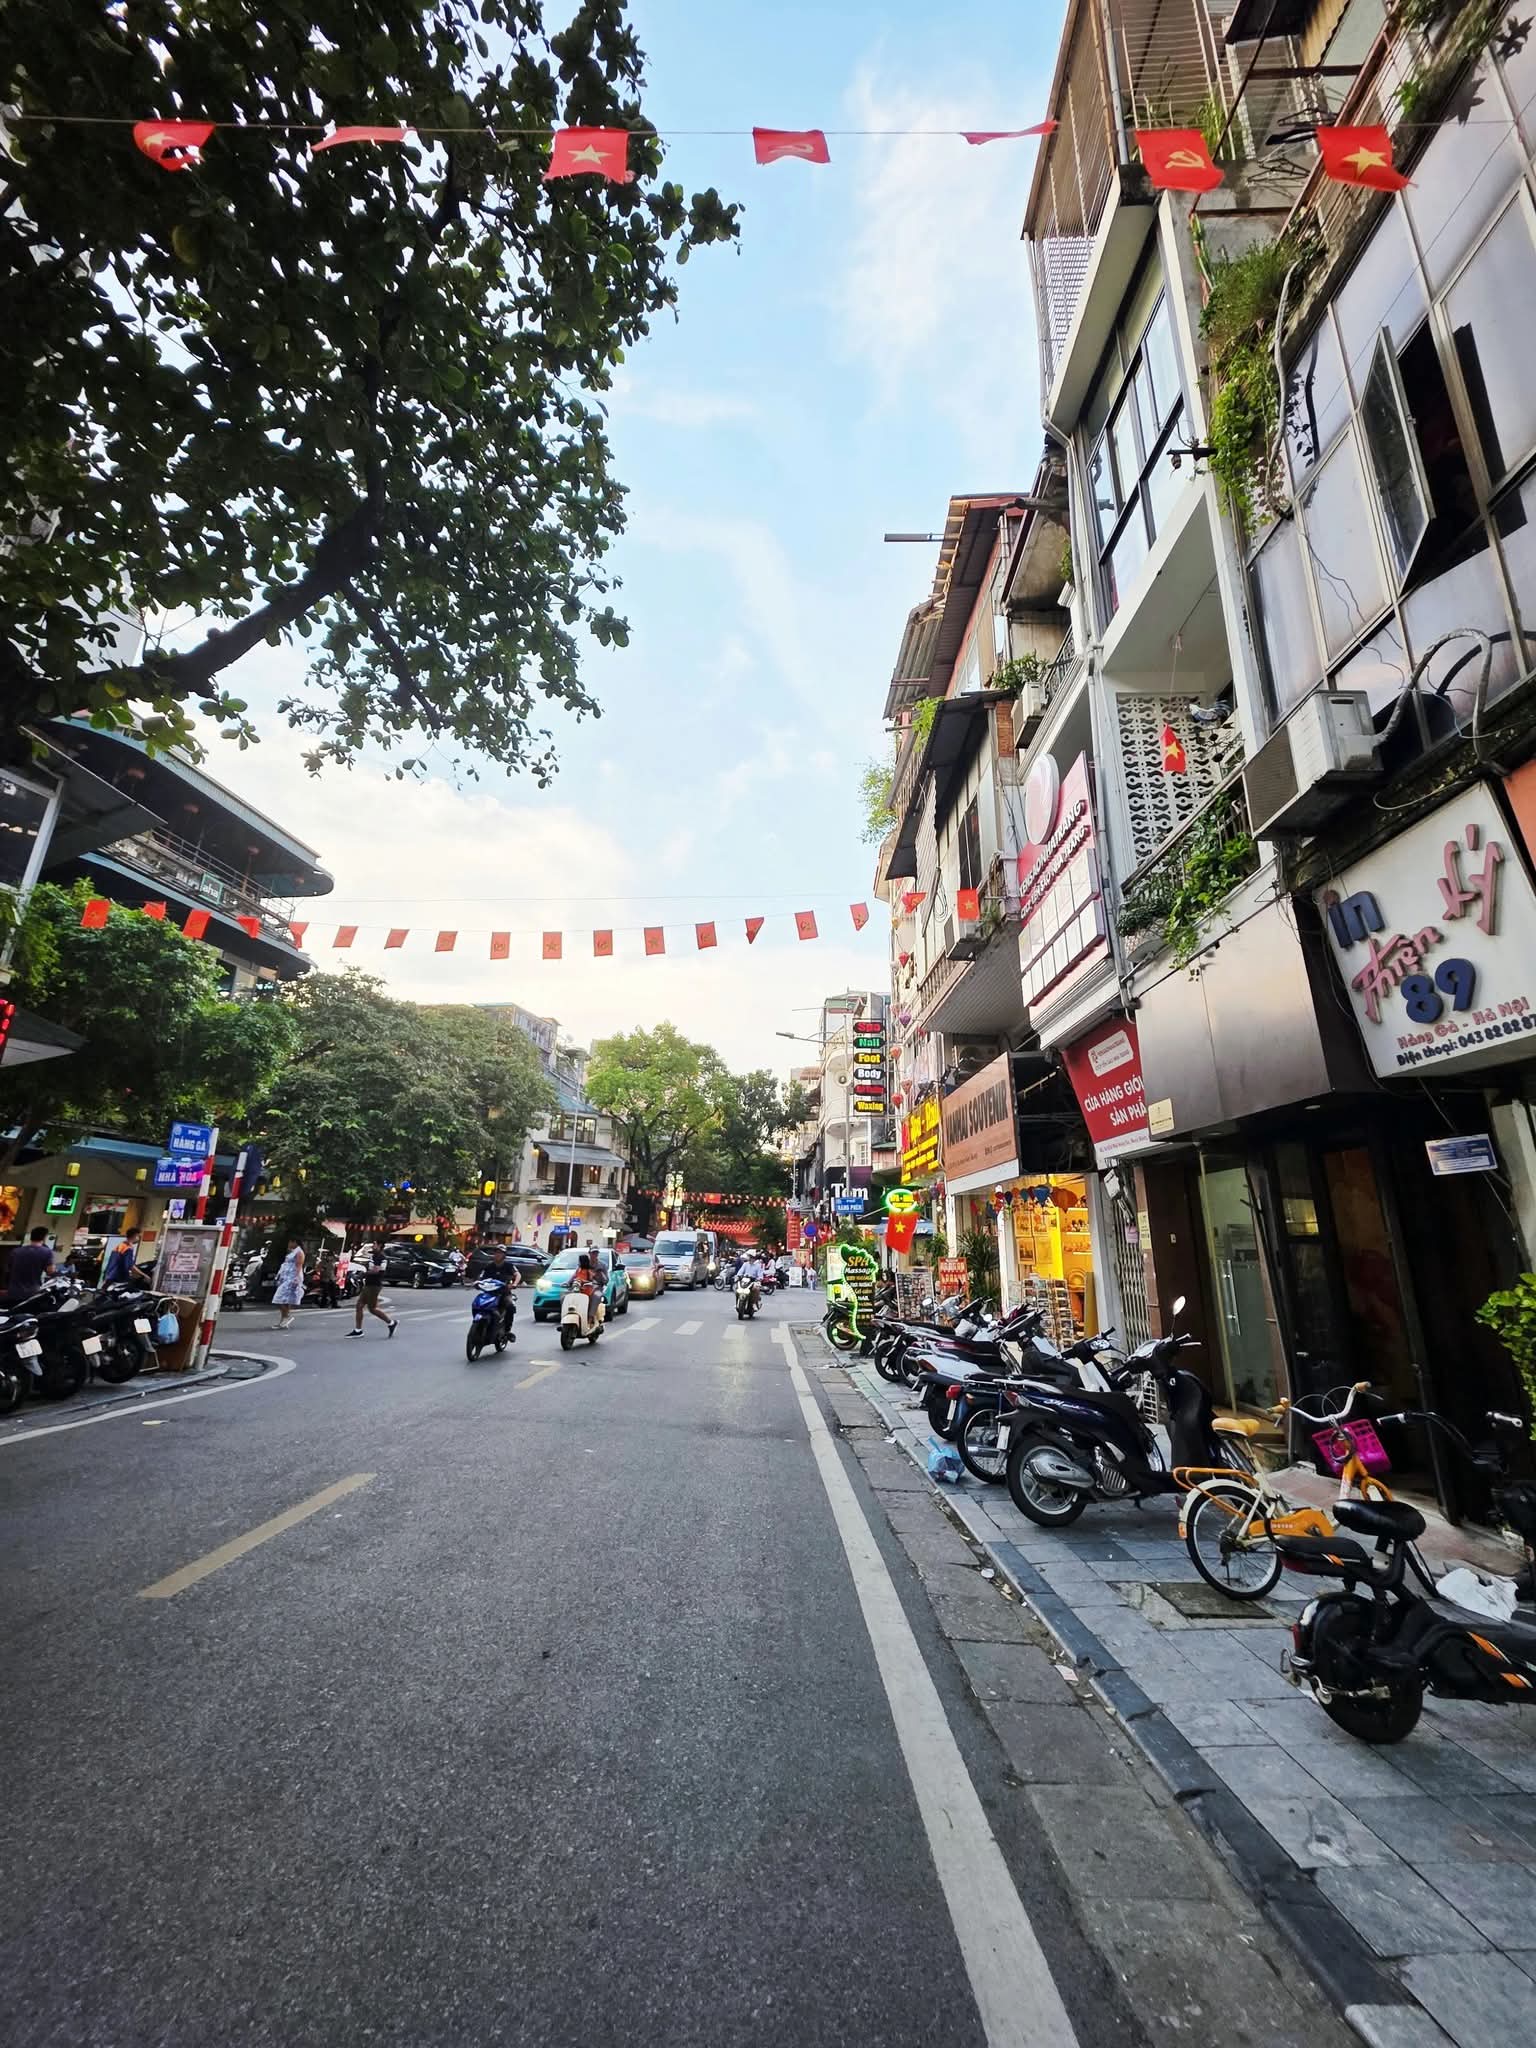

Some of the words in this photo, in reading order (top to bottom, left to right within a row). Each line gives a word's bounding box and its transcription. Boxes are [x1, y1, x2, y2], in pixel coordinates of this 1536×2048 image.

[1400, 958, 1477, 1024] 89
[858, 1053, 880, 1063] Foot
[857, 1069, 881, 1080] Body
